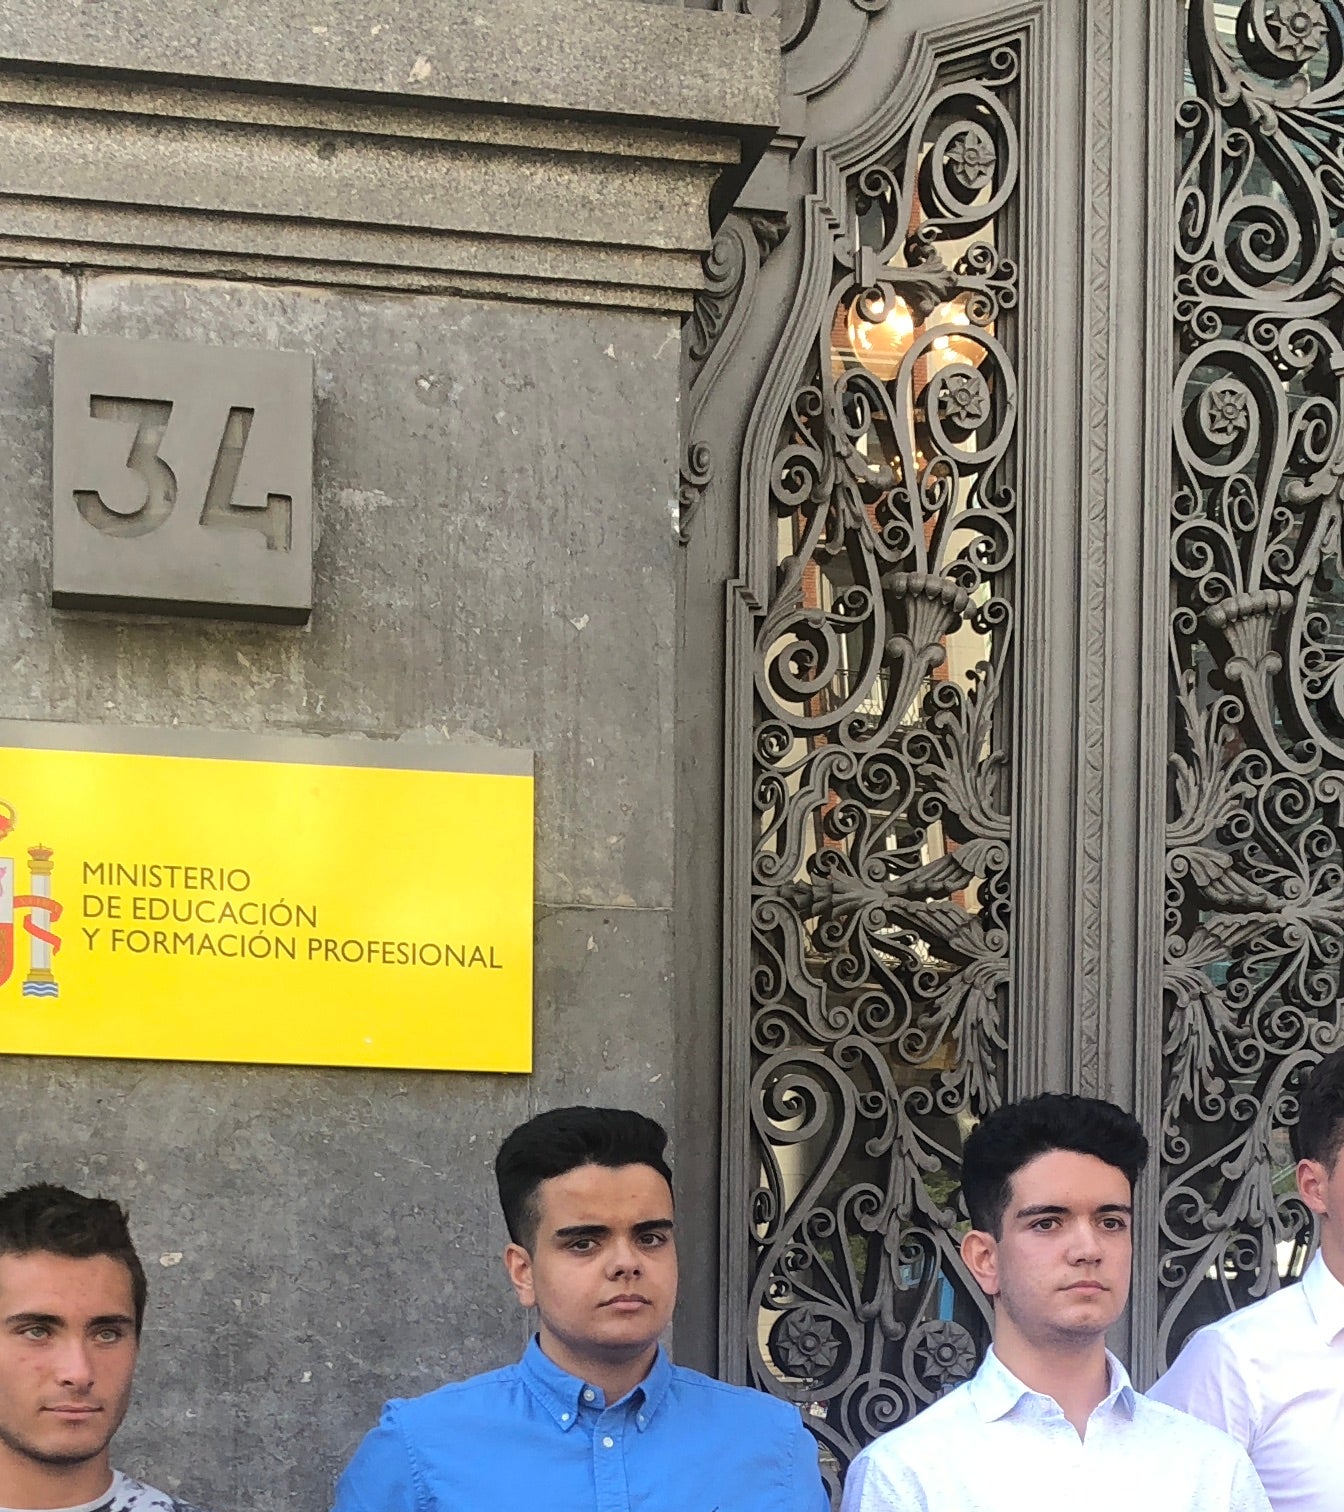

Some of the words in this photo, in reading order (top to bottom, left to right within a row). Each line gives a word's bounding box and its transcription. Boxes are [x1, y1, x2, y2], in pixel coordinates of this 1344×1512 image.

[72, 394, 292, 551] 34
[82, 861, 251, 892] MINISTERIO
[83, 894, 122, 919] DE
[133, 897, 317, 928] EDUCACIÓN
[81, 927, 101, 951] Y
[111, 929, 296, 960] FORMACIÓN
[308, 938, 503, 969] PROFESIONAL
